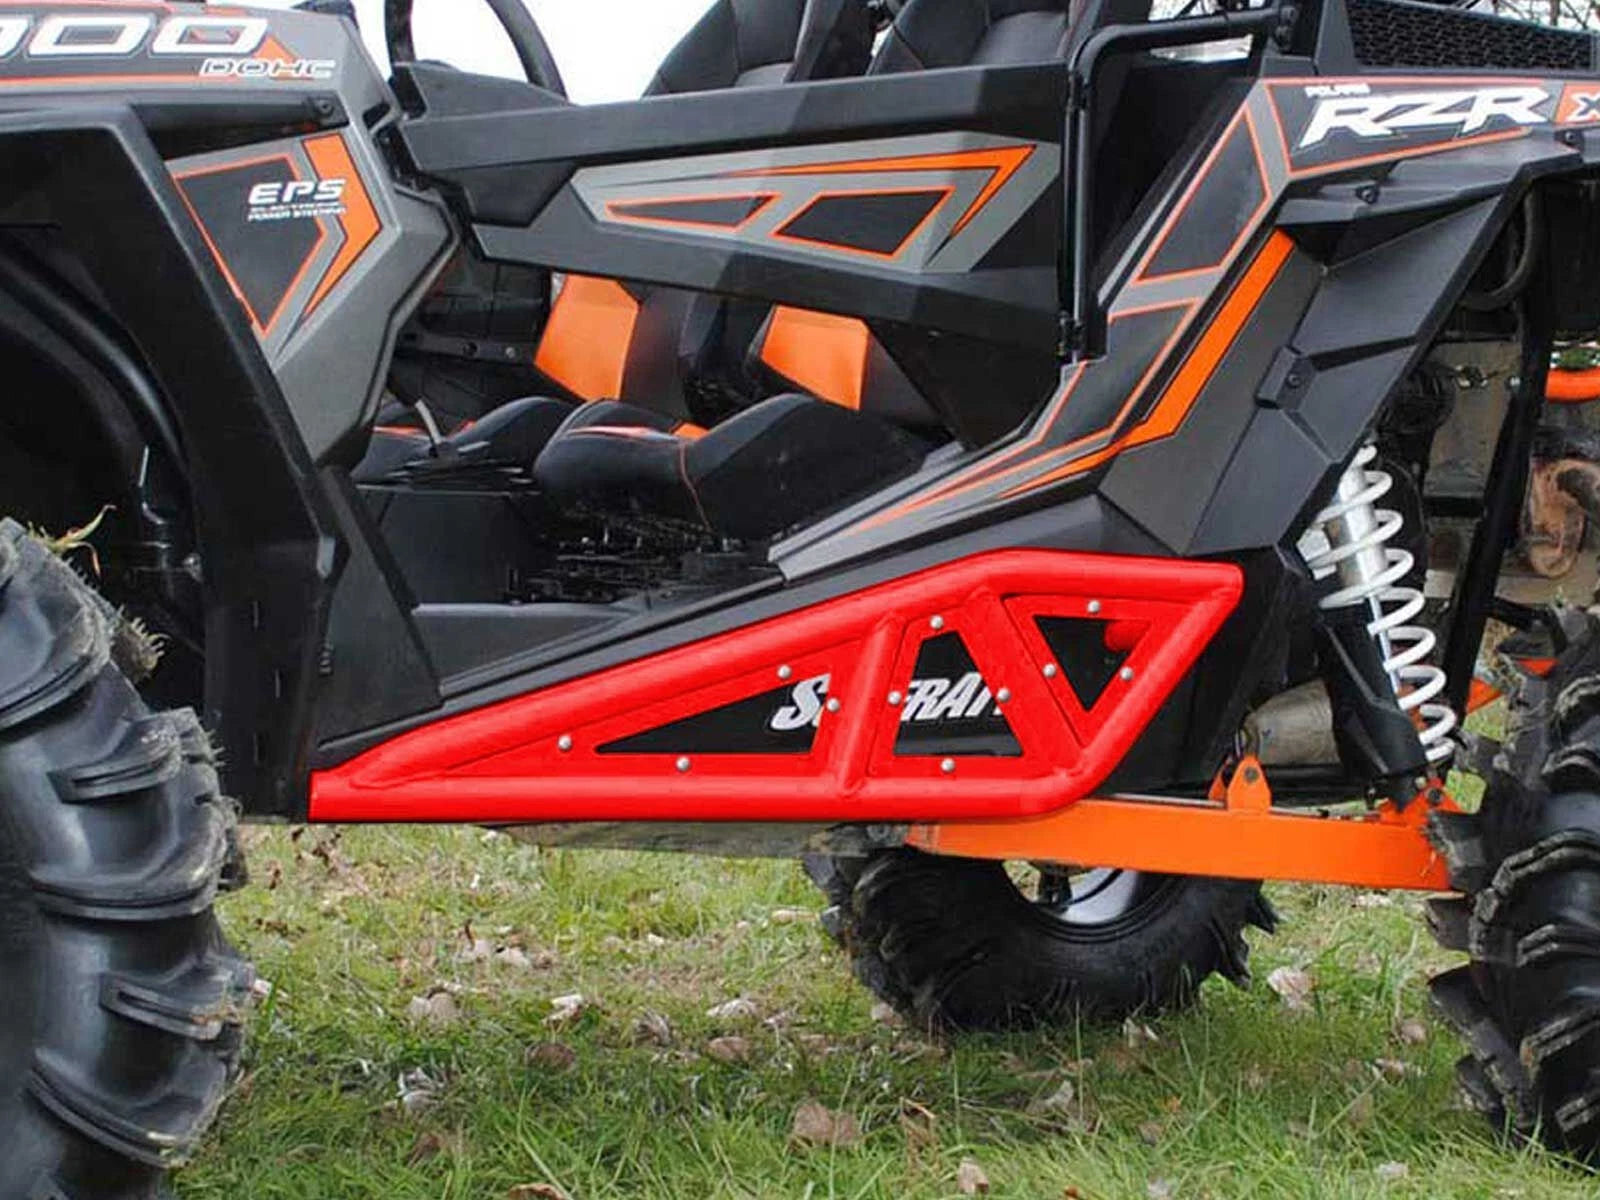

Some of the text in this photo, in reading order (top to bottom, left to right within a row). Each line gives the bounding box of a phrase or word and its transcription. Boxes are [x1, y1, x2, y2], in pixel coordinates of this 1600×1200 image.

[199, 57, 337, 78] DOHC
[1299, 86, 1549, 148] RZR
[248, 179, 346, 205] EPS
